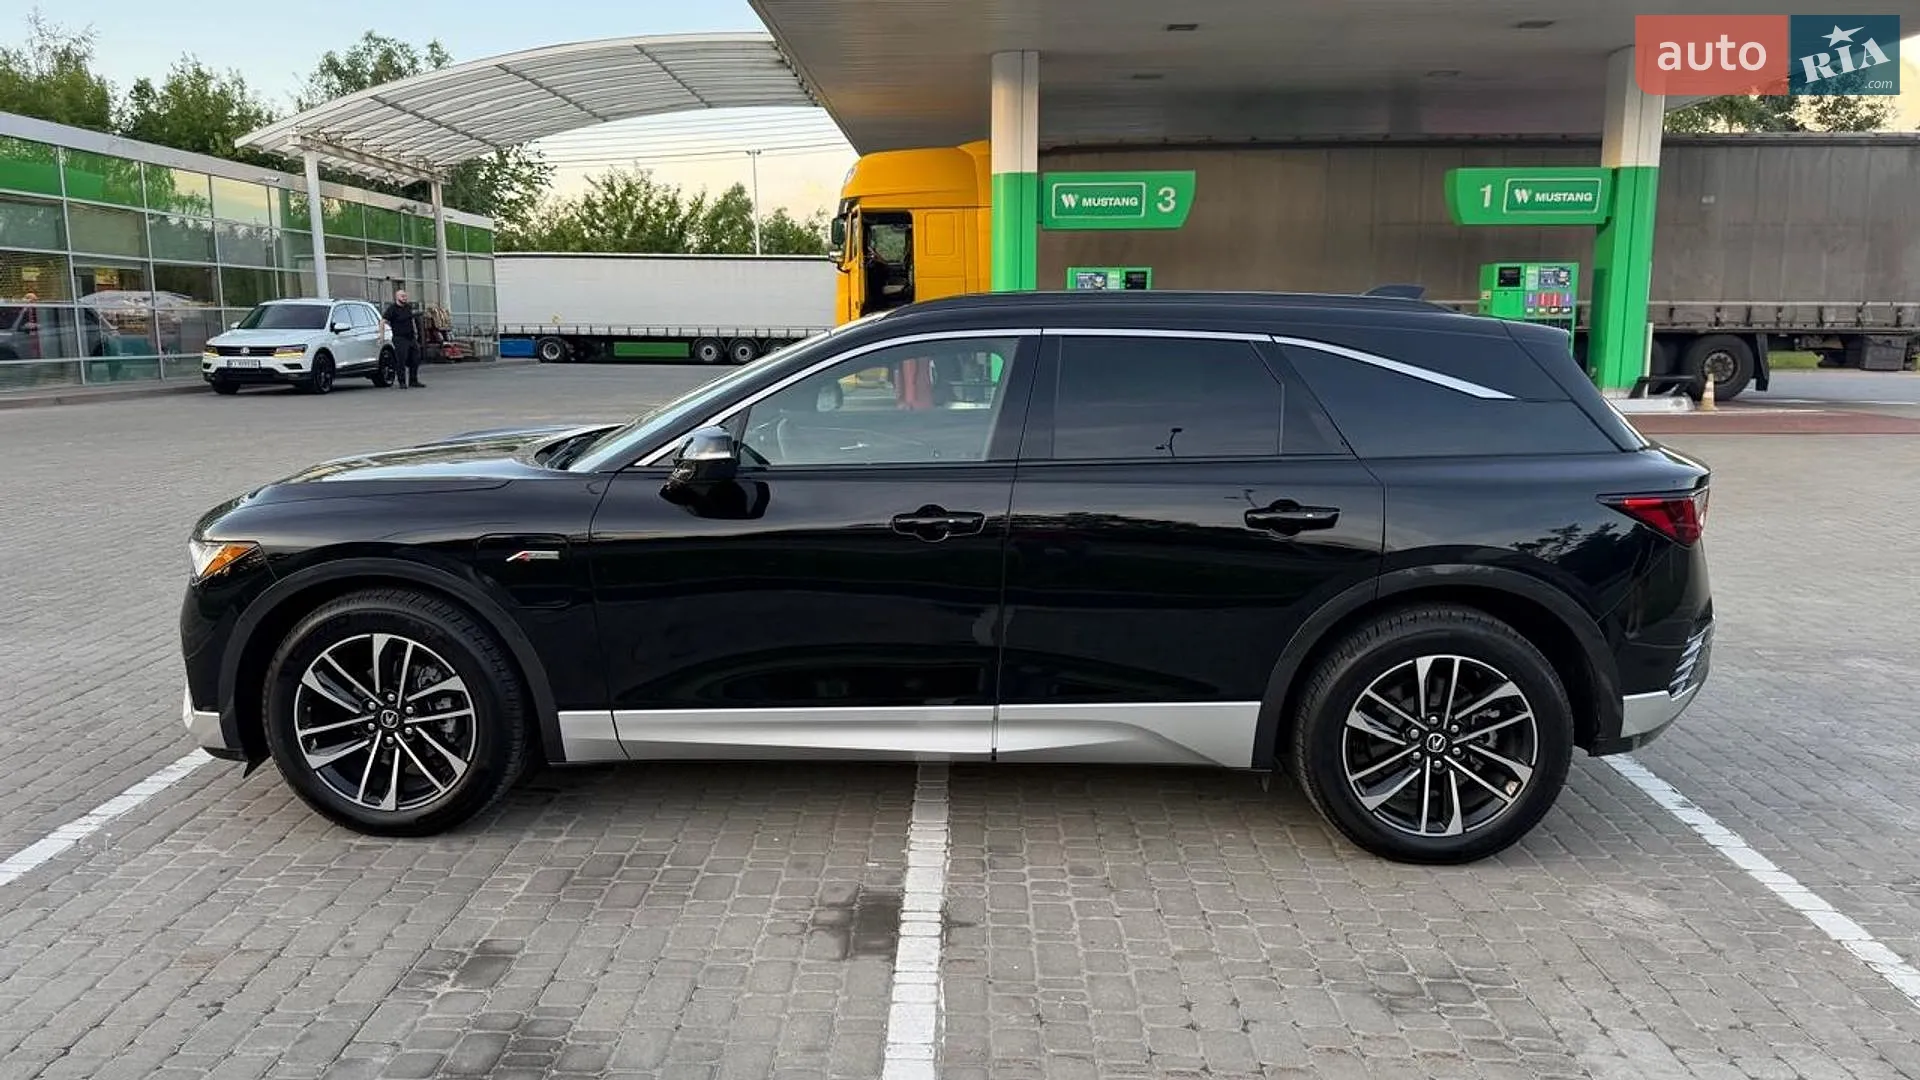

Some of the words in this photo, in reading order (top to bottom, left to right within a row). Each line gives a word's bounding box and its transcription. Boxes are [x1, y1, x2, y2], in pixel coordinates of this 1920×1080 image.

[1081, 196, 1138, 207] MUSTANG
[1156, 186, 1176, 213] 3
[1480, 184, 1493, 208] 1
[1535, 192, 1593, 202] MUSTANG
